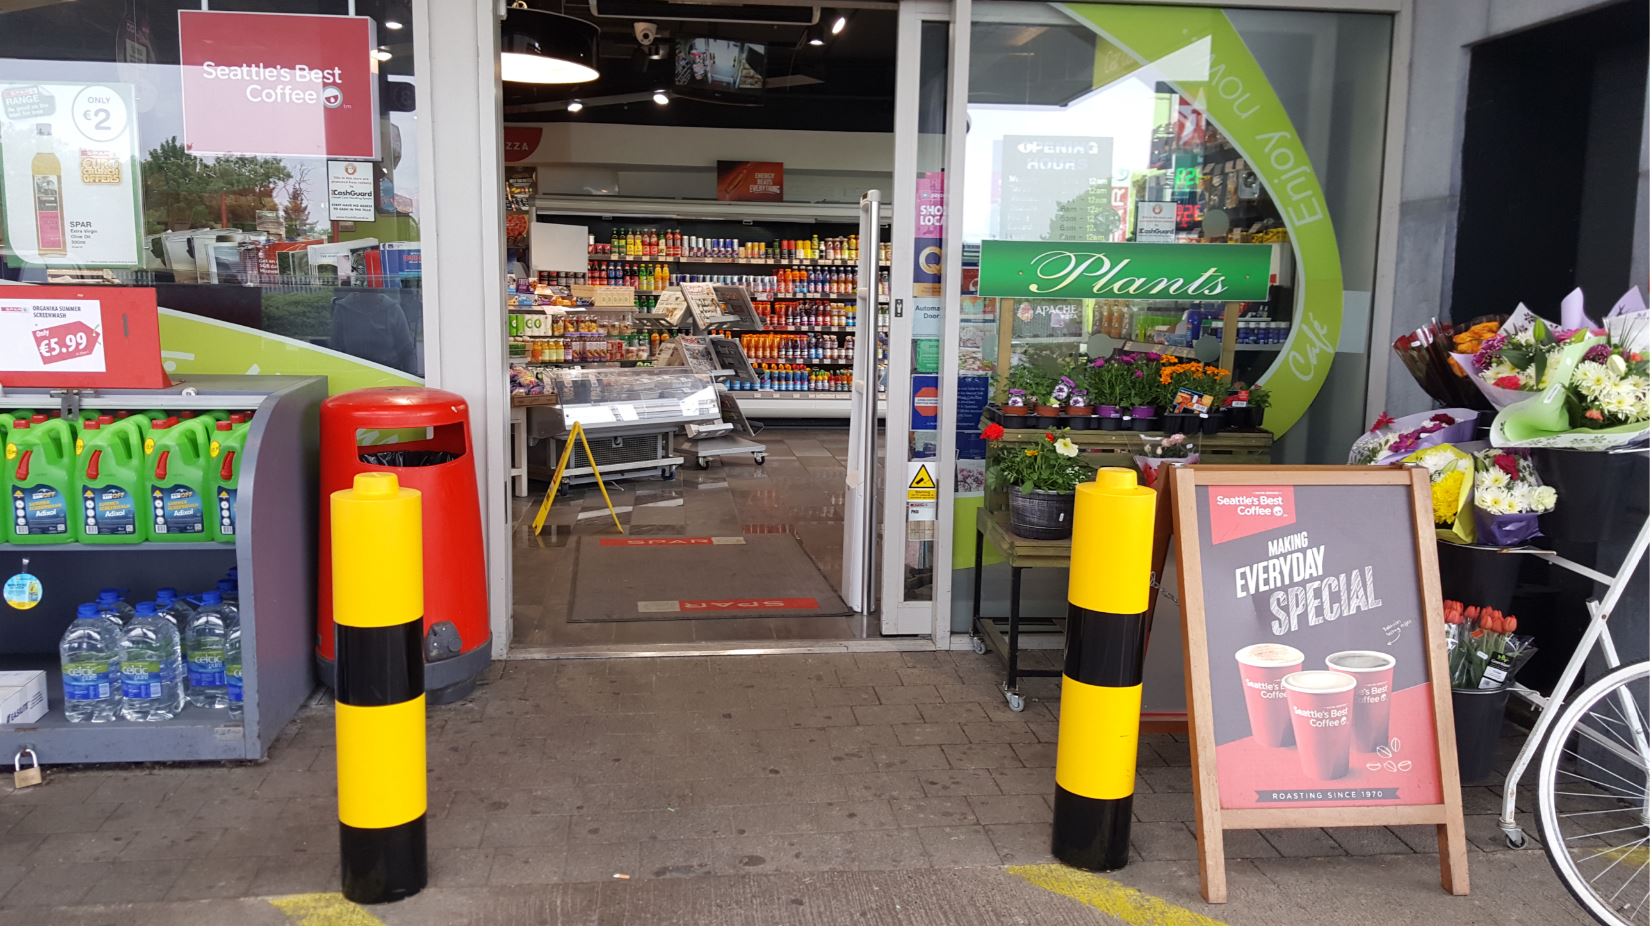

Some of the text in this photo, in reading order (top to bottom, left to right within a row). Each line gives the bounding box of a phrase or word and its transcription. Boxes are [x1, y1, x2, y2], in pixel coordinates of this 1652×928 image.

[203, 61, 342, 83] Seattle's Best
[246, 84, 318, 103] Coffee
[6, 94, 40, 106] RANGE
[88, 96, 111, 104] ONLY
[83, 108, 111, 130] €2
[505, 142, 528, 150] ZZA
[1256, 131, 1322, 226] Enjoy
[333, 189, 372, 197] CashGuard
[920, 205, 943, 215] SHO
[1030, 249, 1229, 296] Plants
[1035, 304, 1078, 316] APACHE
[35, 329, 49, 338] Only
[39, 332, 87, 357] €5.99
[1289, 312, 1333, 381] Café
[1217, 496, 1283, 505] Seattle's Best
[1237, 506, 1271, 515] Coffee
[1268, 531, 1308, 557] MAKING
[1235, 545, 1325, 598] EVERYDAY
[685, 600, 785, 609] SPAR
[1269, 566, 1382, 636] SPECIAL
[1371, 685, 1388, 695] Best
[1293, 705, 1348, 719] Seattle's Best
[1309, 718, 1340, 728] Coffee
[1272, 790, 1383, 800] ROASTING SINCE 1970
